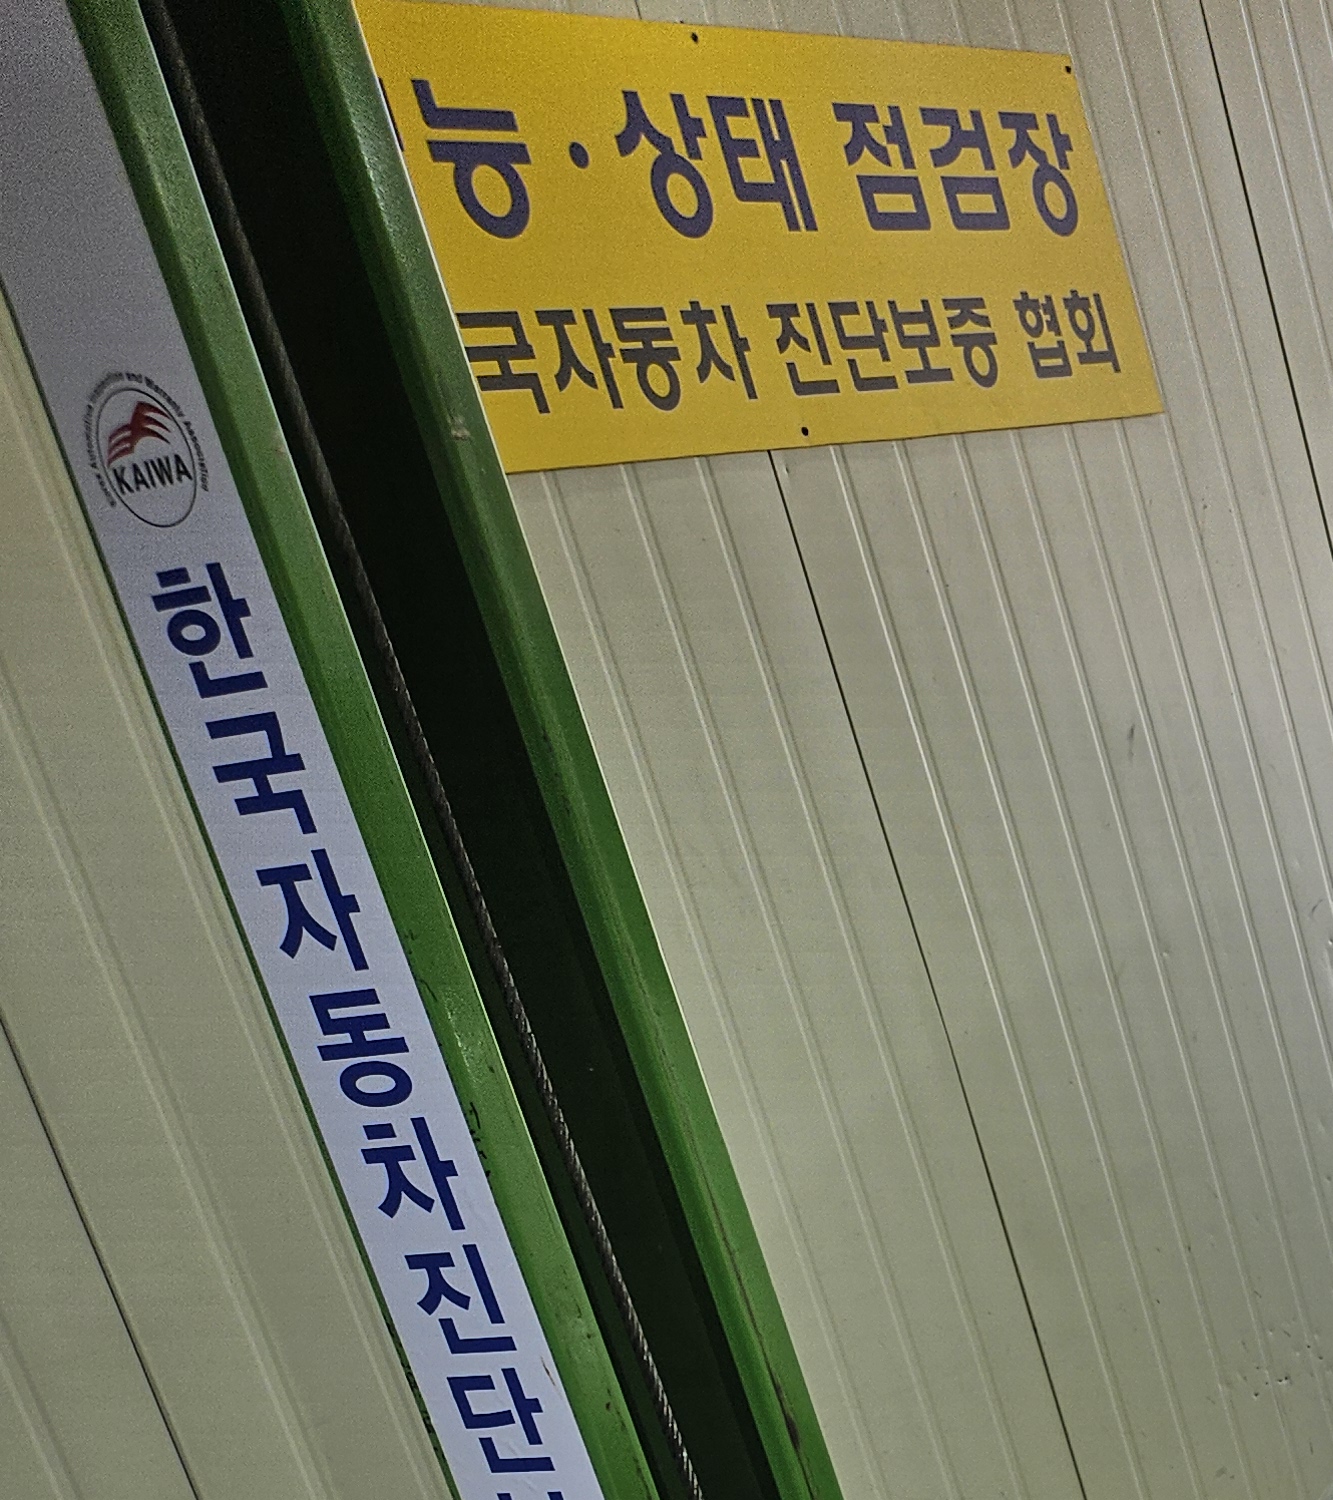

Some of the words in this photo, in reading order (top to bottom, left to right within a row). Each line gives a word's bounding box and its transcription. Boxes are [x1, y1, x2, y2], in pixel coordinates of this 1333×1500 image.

[379, 78, 818, 239] 능·상태
[832, 102, 1078, 237] 점검장
[766, 297, 998, 397] 진단보증
[1012, 289, 1121, 379] 협회
[112, 453, 193, 496] KAIWA
